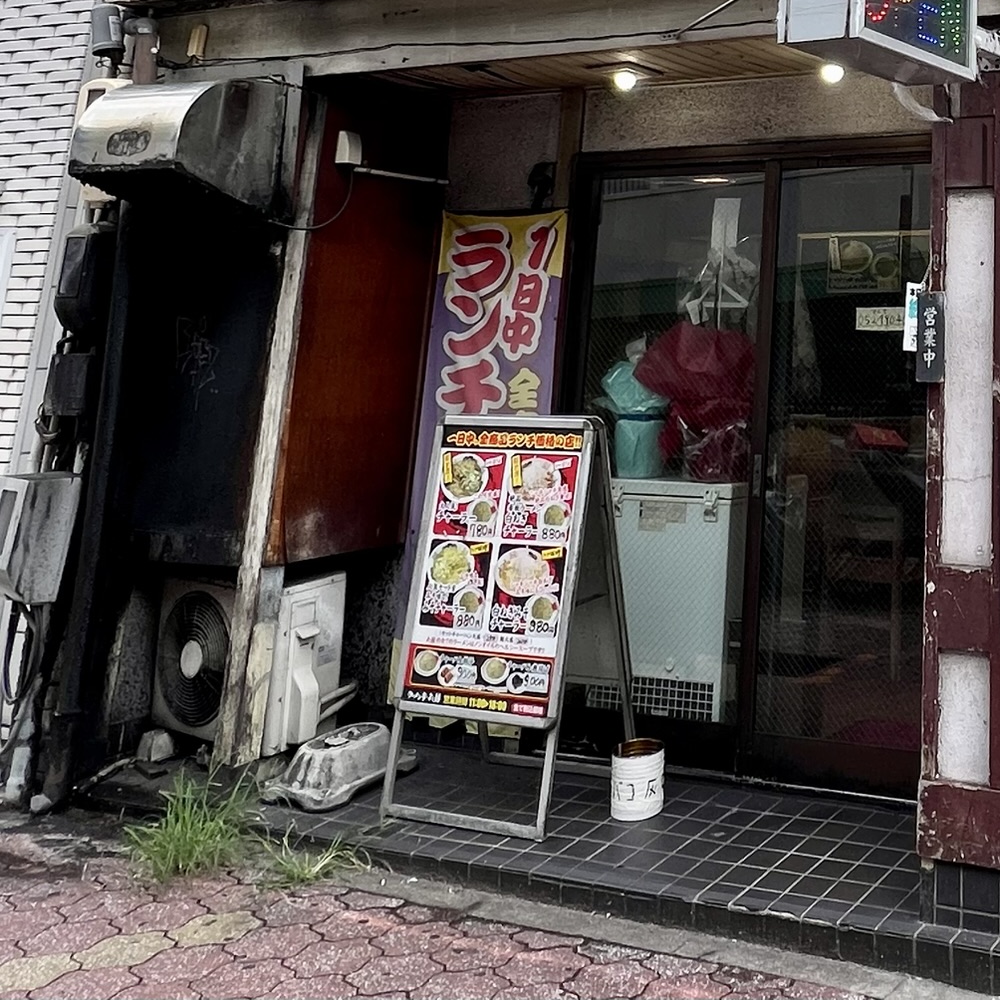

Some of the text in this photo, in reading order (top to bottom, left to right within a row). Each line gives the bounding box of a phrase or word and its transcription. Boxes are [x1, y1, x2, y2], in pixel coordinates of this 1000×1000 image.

[440, 228, 508, 414] ランチ
[501, 225, 551, 354] 1日中
[923, 305, 938, 369] 営業中
[508, 367, 542, 415] 全
